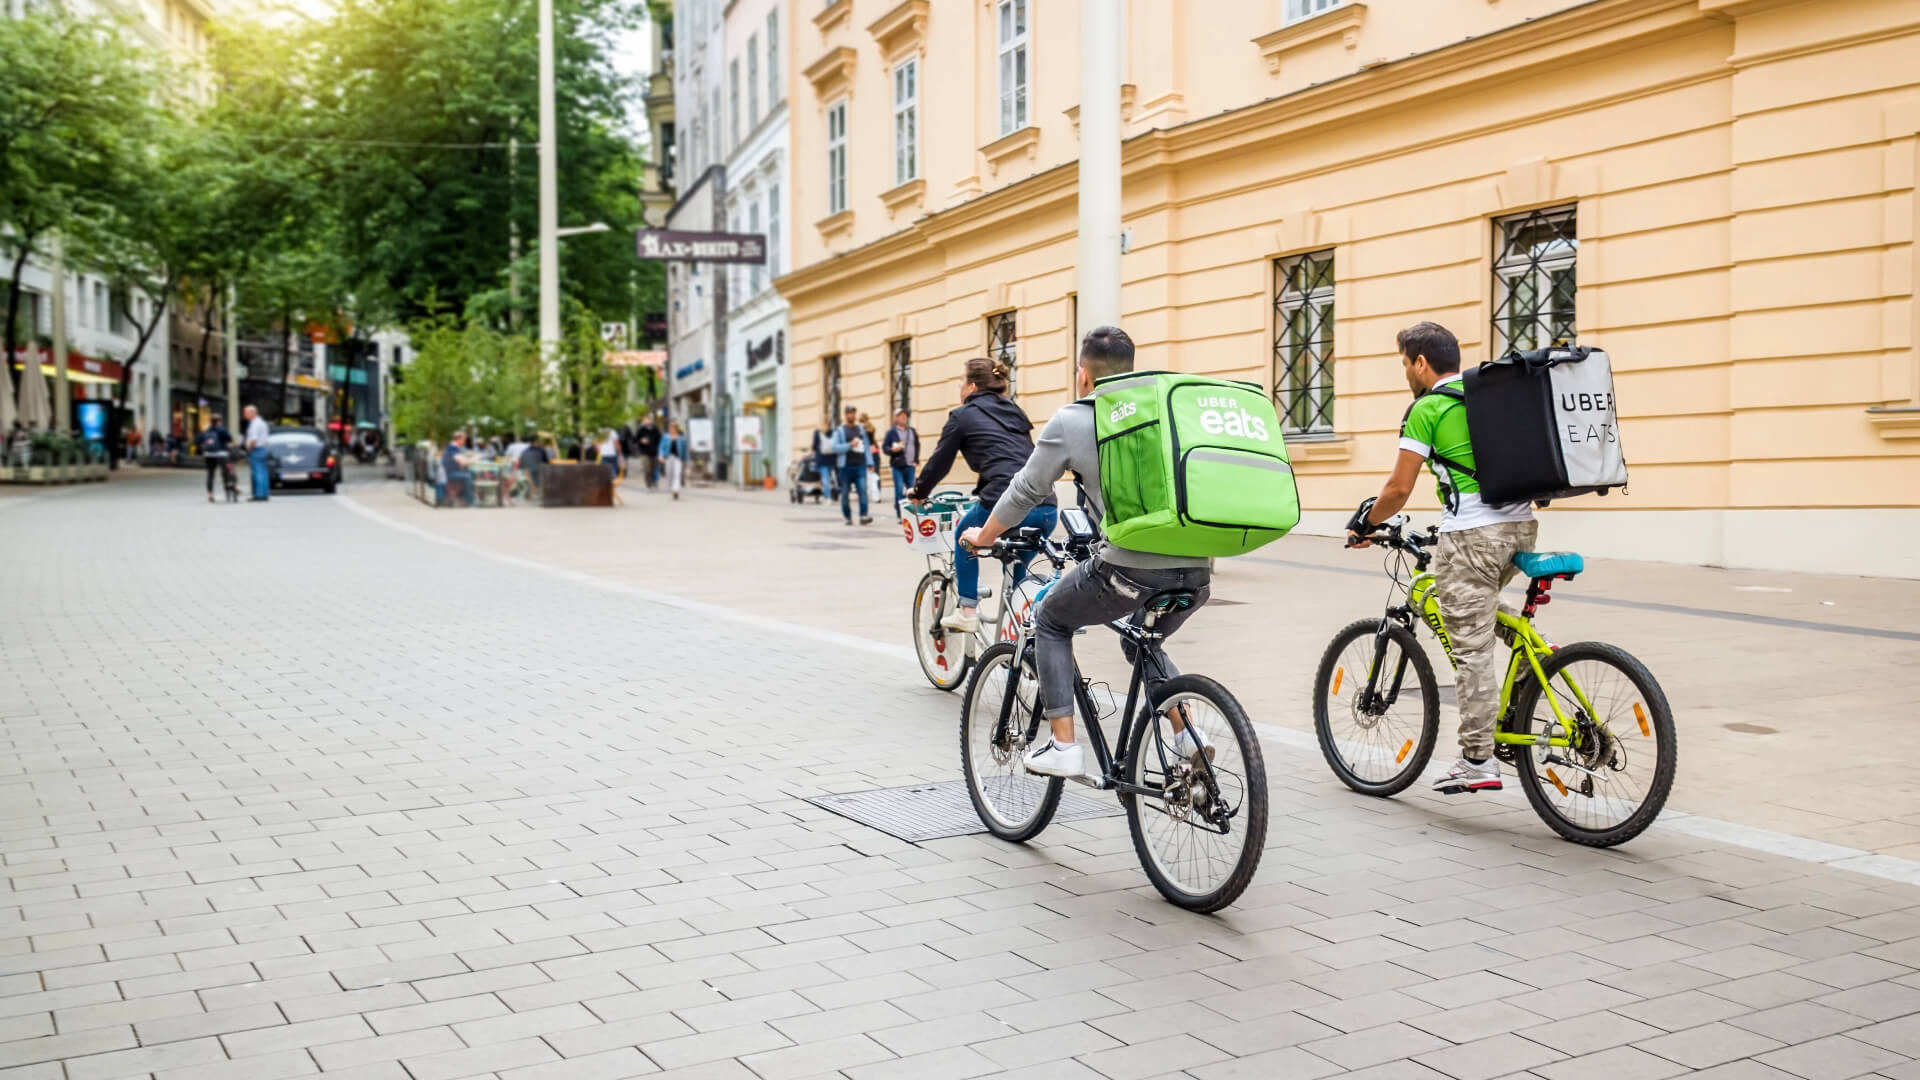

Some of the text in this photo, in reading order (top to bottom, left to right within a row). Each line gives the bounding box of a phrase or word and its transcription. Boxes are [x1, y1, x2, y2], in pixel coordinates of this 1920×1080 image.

[1110, 401, 1137, 423] eats
[1197, 396, 1238, 409] UBER
[1562, 393, 1615, 411] UBER
[1200, 407, 1269, 441] eats
[1567, 423, 1616, 443] EATS
